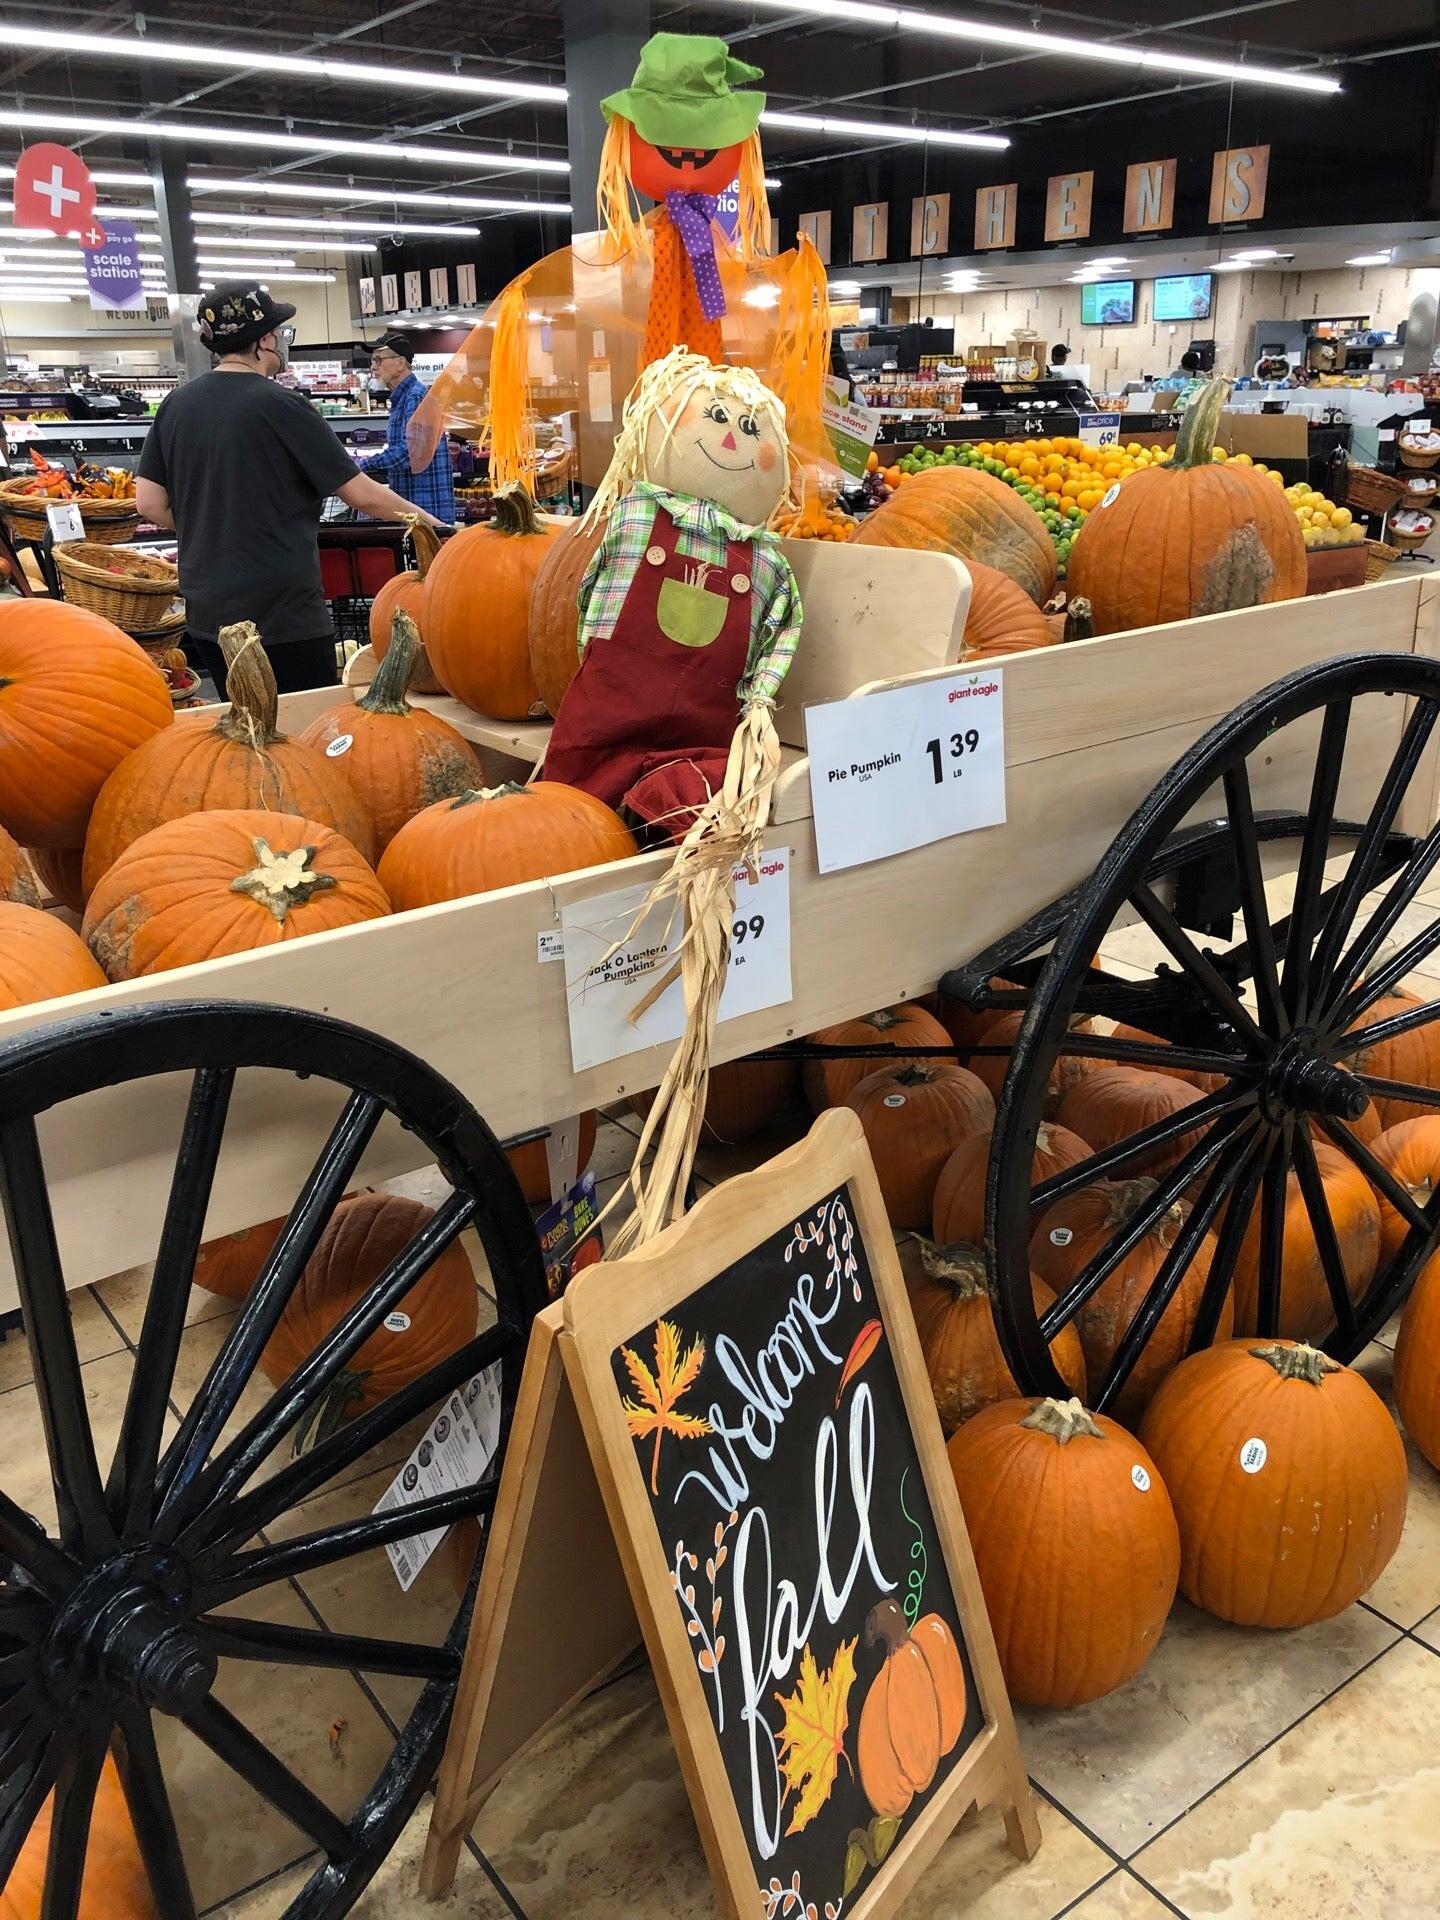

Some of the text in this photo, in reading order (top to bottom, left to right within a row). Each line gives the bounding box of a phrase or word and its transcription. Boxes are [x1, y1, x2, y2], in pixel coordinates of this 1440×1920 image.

[811, 153, 1254, 257] ITCHENS
[93, 253, 132, 266] scale
[90, 266, 138, 278] station
[411, 363, 444, 371] olive pit
[842, 415, 868, 432] stand
[948, 682, 999, 703] giant eagle
[828, 752, 902, 783] Pie Pumpkin
[953, 769, 963, 779] LB
[858, 774, 873, 783] USA
[760, 861, 785, 876] agle
[615, 957, 624, 967] O
[735, 956, 746, 966] EA
[604, 960, 656, 981] Pumpkins
